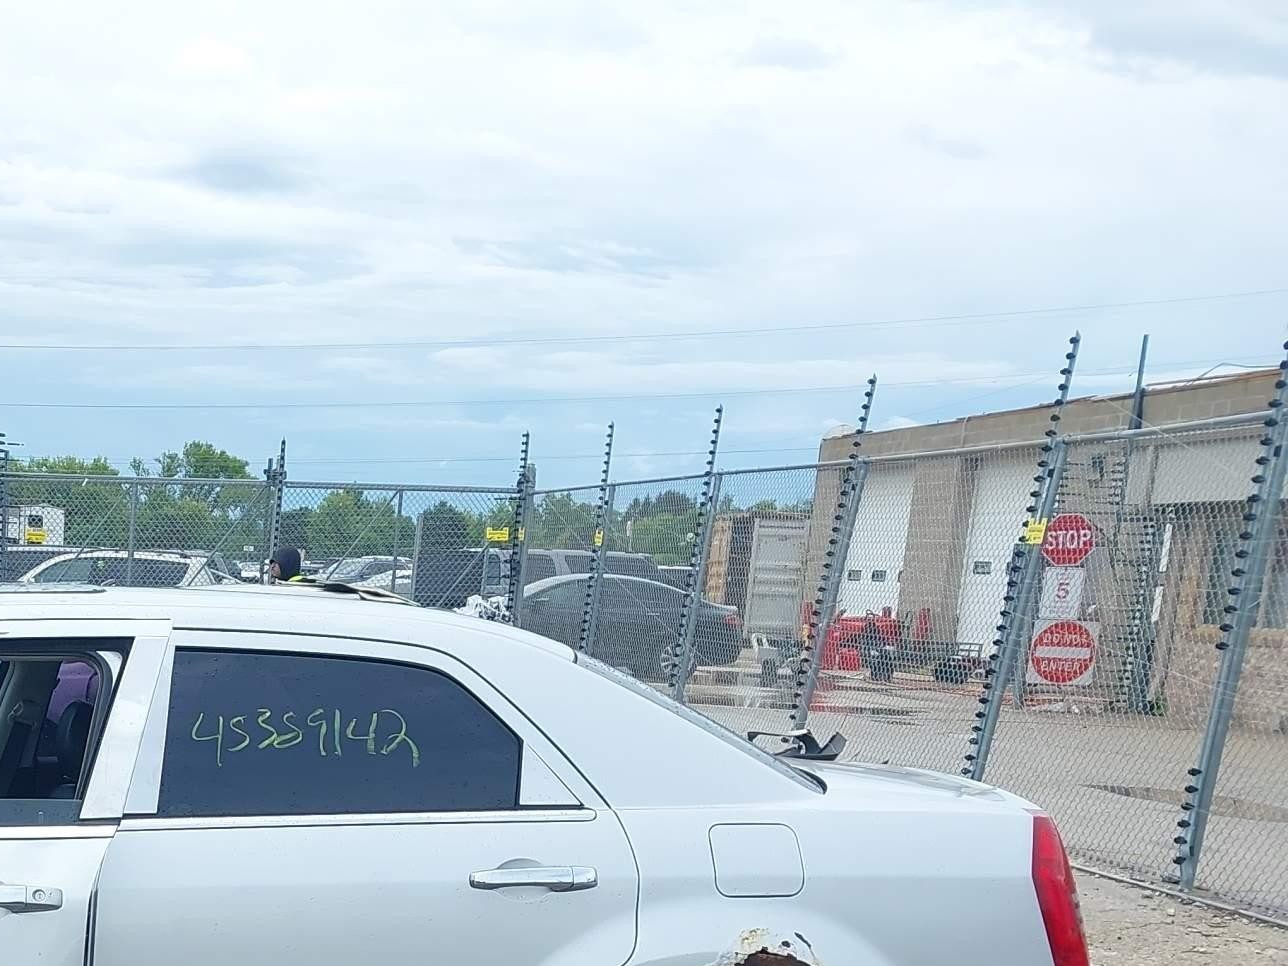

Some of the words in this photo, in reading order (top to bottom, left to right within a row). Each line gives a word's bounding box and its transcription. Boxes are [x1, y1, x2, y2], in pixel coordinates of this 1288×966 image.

[1045, 529, 1092, 549] STOP
[1056, 582, 1070, 599] 5
[1043, 632, 1060, 643] DO
[1042, 660, 1081, 672] ENTER
